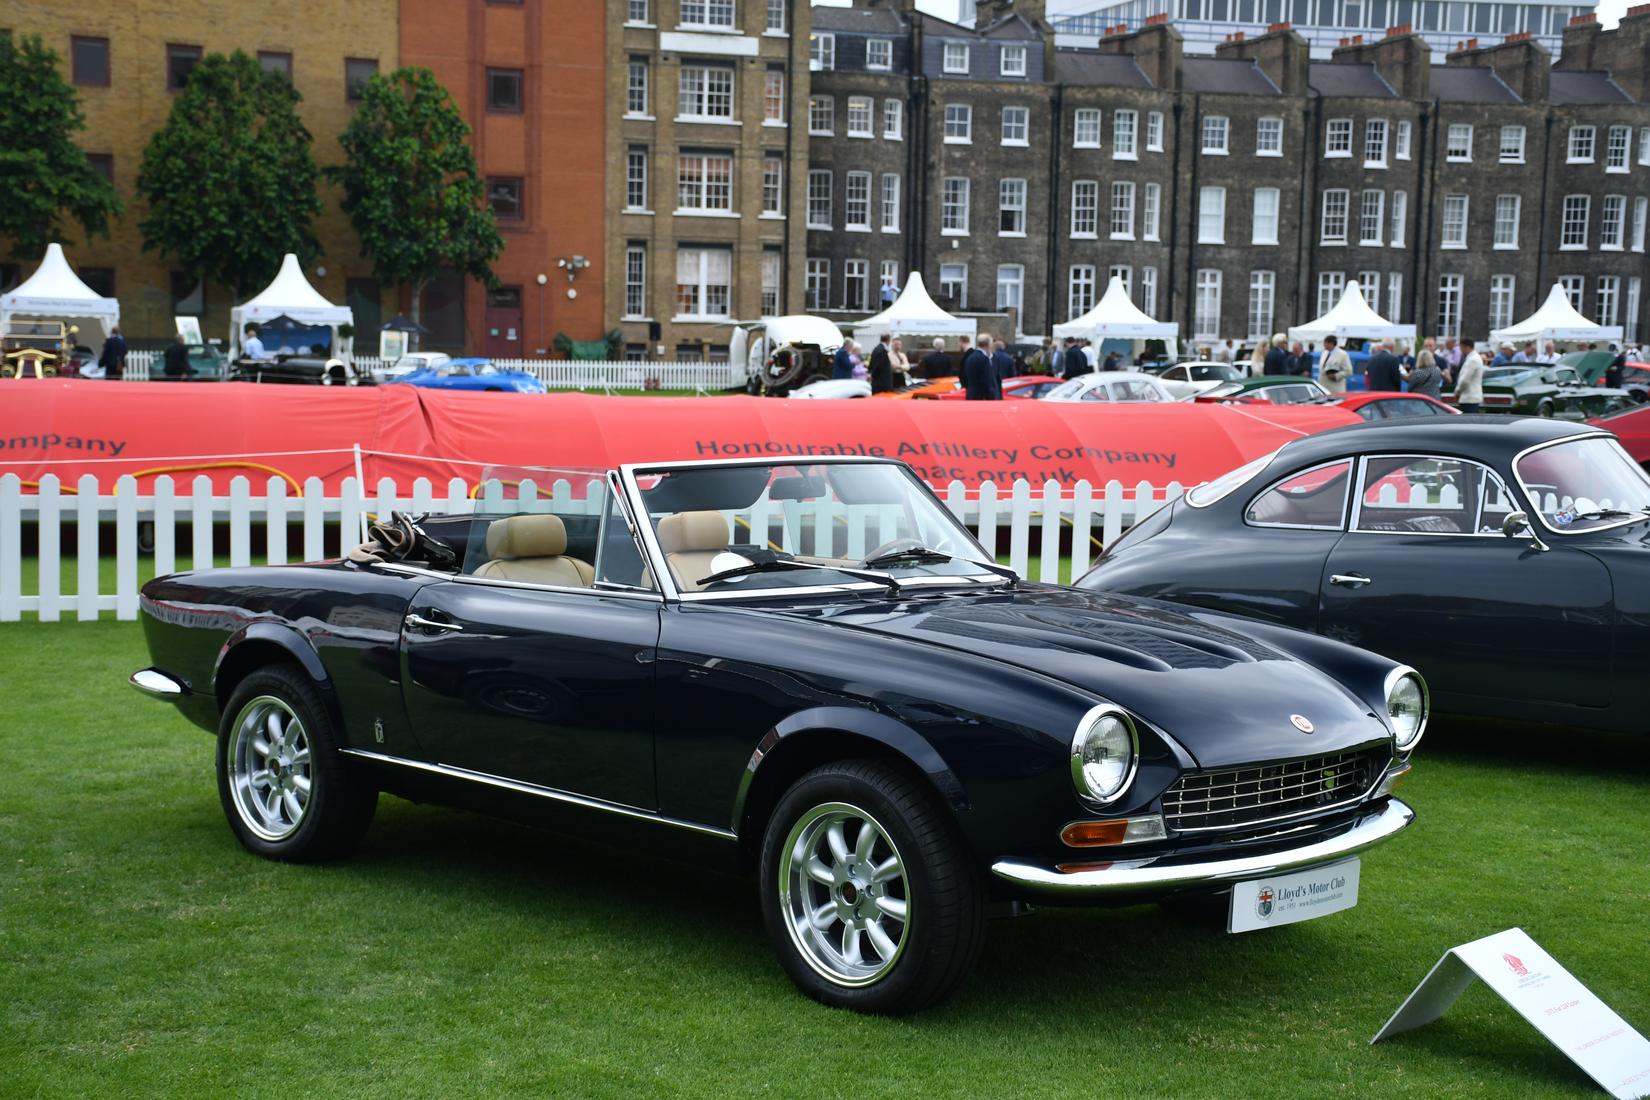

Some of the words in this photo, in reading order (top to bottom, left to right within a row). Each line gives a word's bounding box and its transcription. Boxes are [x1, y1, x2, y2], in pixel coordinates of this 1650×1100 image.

[695, 440, 885, 457] Honourable
[897, 441, 1018, 465] Artillery
[1029, 445, 1177, 468] Company
[1278, 886, 1306, 902] Lloyd's
[1307, 883, 1329, 895] Motor
[1330, 876, 1345, 890] Club
